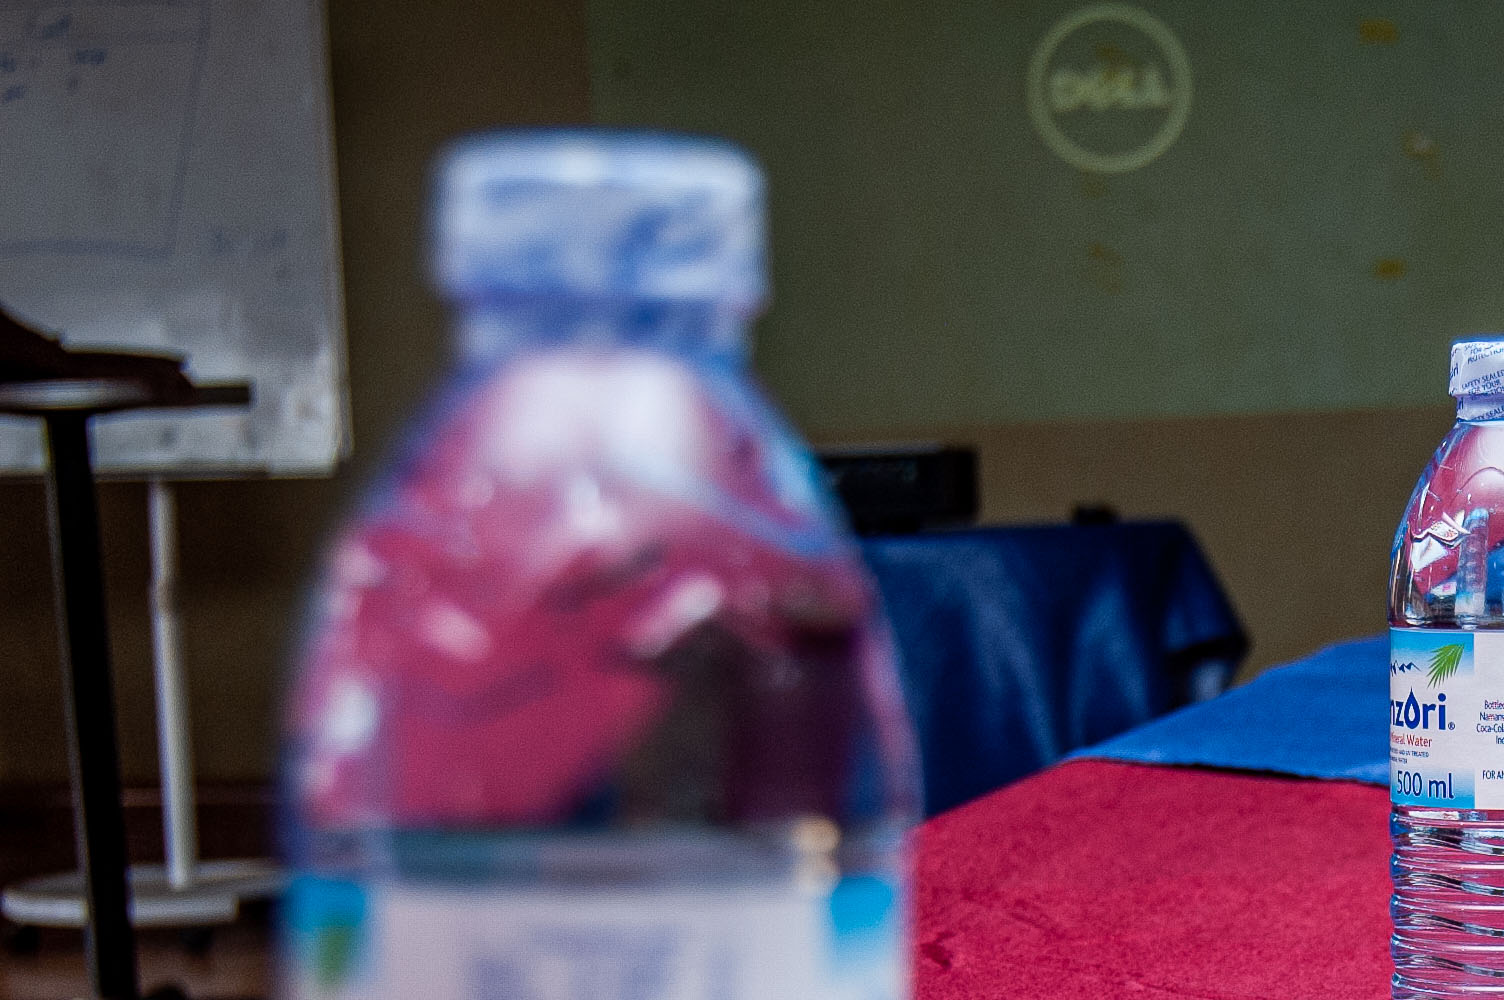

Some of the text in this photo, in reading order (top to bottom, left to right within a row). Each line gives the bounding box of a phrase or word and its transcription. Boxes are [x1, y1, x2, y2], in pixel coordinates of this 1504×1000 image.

[1406, 734, 1433, 748] Water
[1482, 769, 1496, 780] FOR
[1396, 770, 1455, 799] 500 ml
